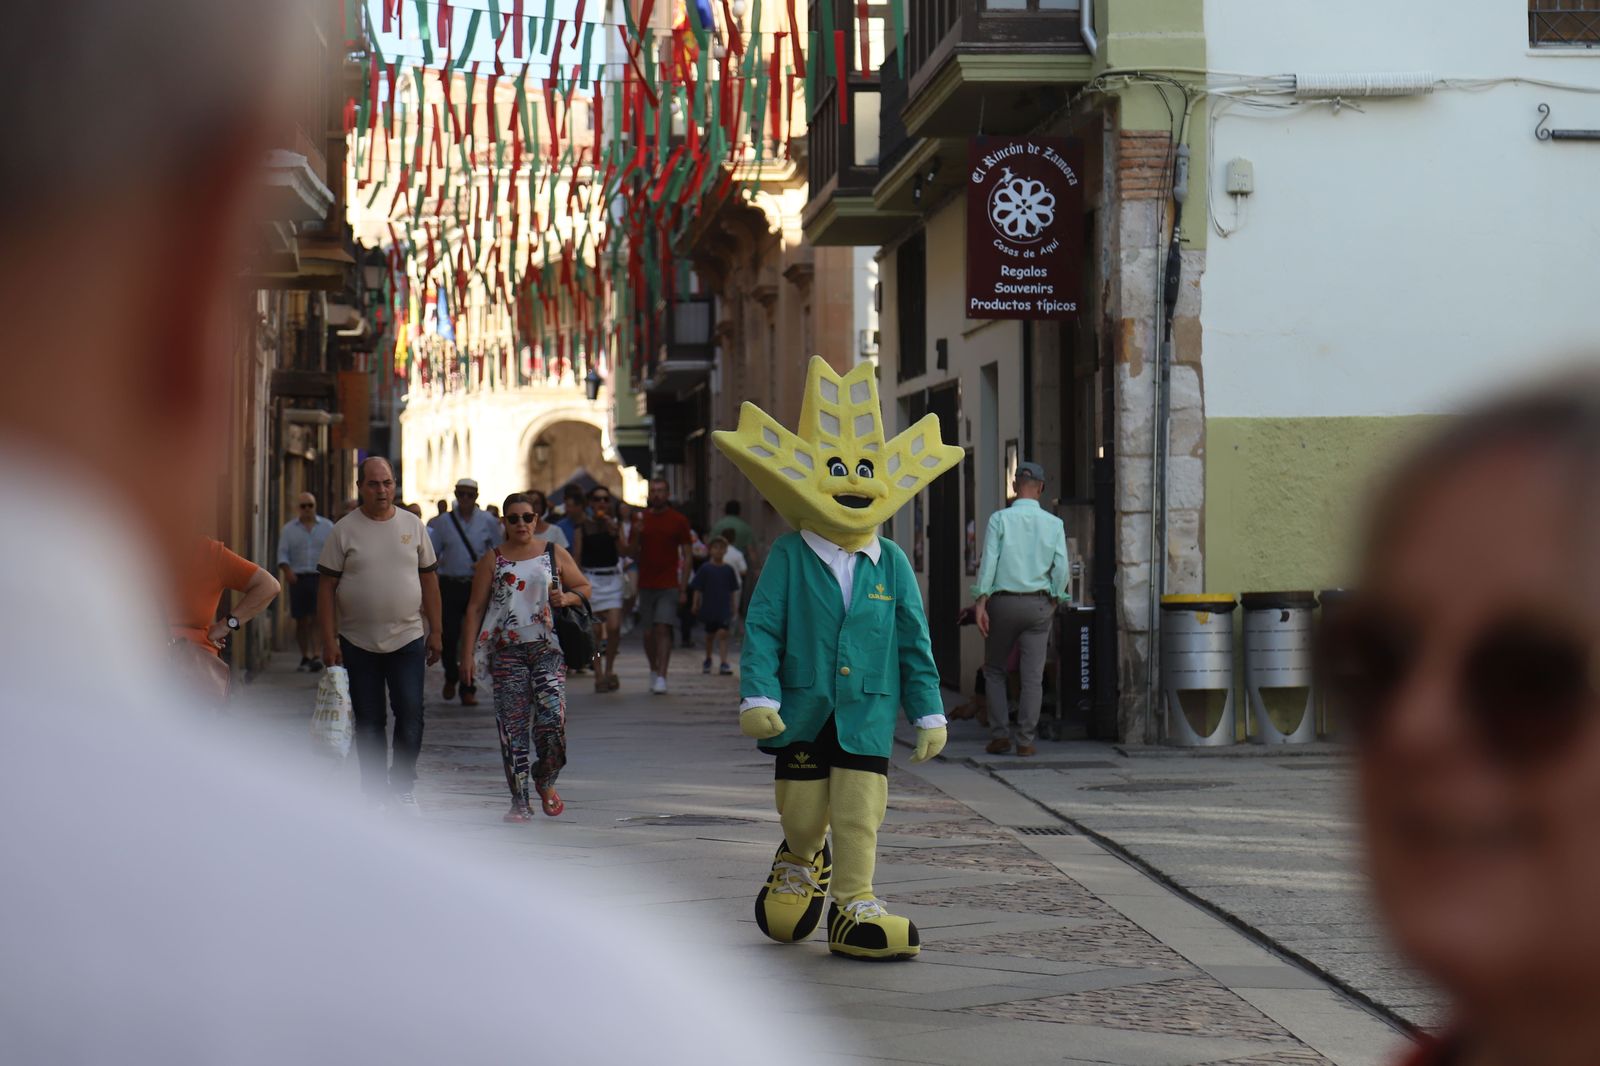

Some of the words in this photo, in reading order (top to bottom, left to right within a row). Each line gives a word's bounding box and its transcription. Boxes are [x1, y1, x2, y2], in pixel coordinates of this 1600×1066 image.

[971, 166, 985, 184] El
[982, 142, 1024, 169] Rincón
[1028, 142, 1040, 155] de
[1042, 147, 1078, 186] Zamora
[993, 239, 1019, 257] Cosas
[1024, 248, 1035, 258] de
[1040, 238, 1059, 256] Aquí
[1001, 265, 1047, 280] Regalos
[995, 282, 1053, 294] Souvenirs
[971, 298, 1031, 311] Productos
[1036, 298, 1076, 314] típicos
[1081, 626, 1089, 690] SOUVENIRS
